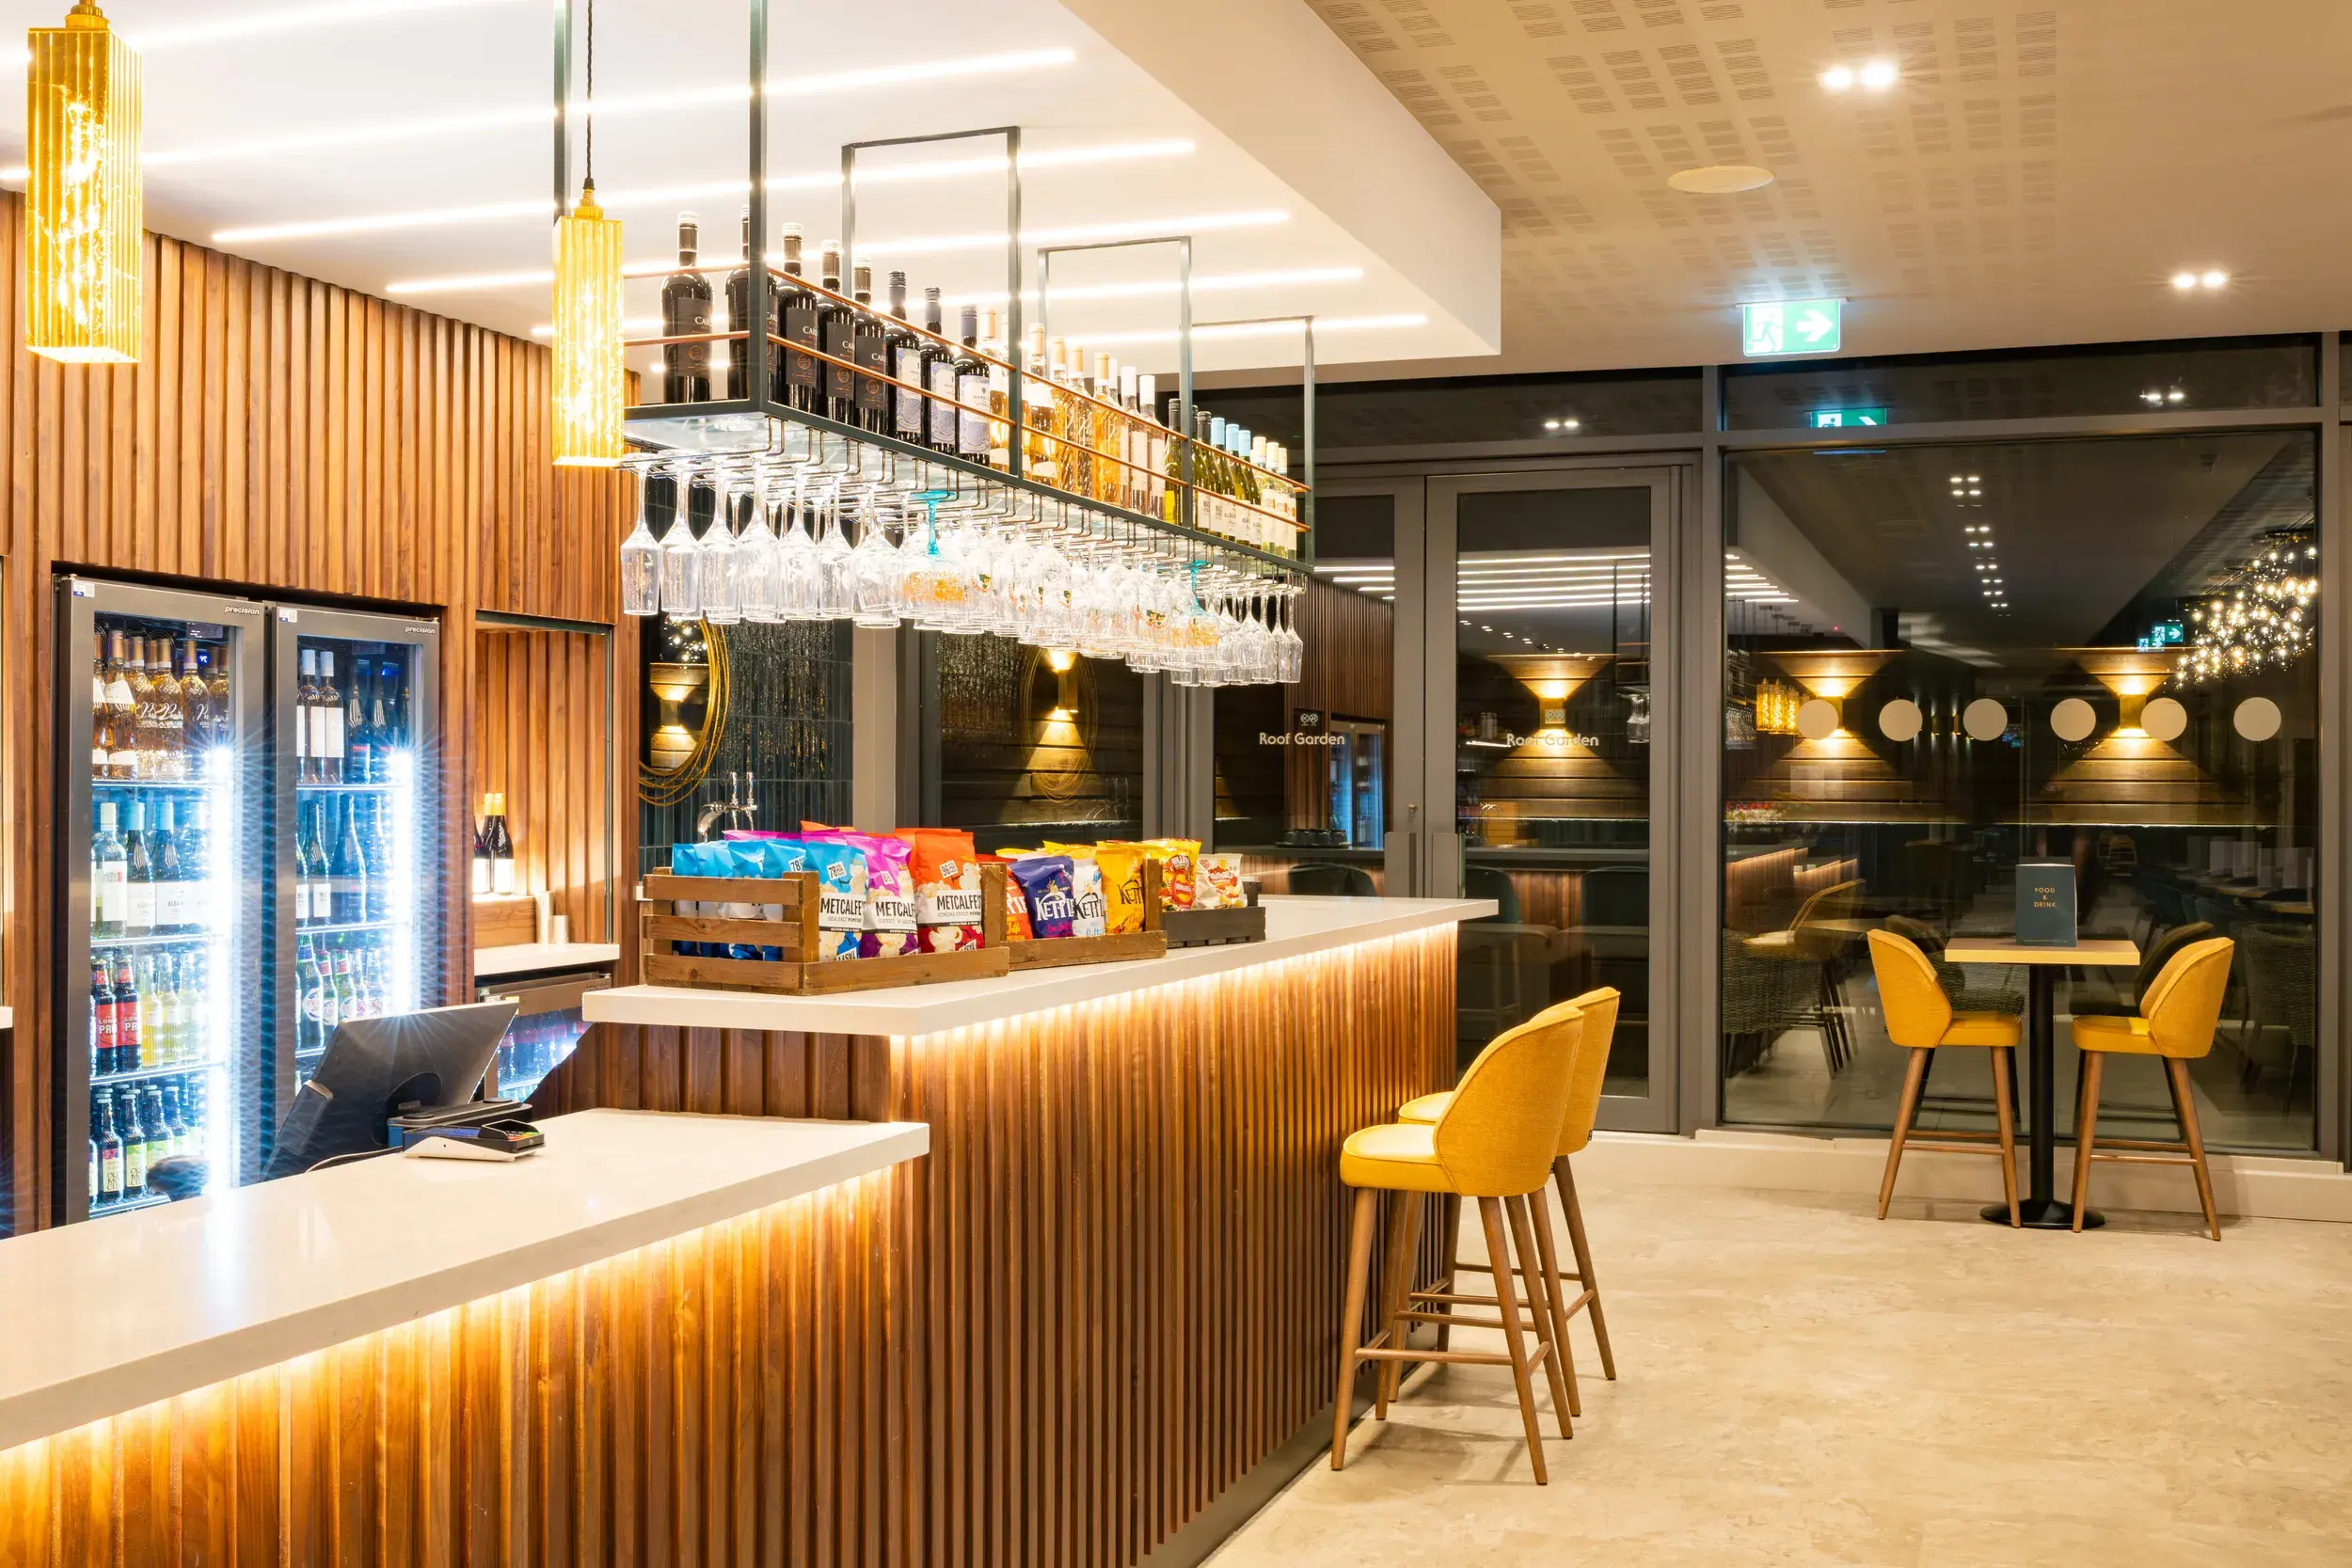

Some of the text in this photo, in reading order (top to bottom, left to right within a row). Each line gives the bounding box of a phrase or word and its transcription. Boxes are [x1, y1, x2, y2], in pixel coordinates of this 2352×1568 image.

[225, 605, 260, 615] precision
[405, 626, 436, 635] precision
[1259, 732, 1345, 745] Roof Garden
[1506, 733, 1599, 747] Roof Garden
[828, 865, 837, 879] 78
[1118, 879, 1143, 905] KETT
[876, 901, 916, 918] METCALF
[1035, 893, 1074, 921] KETTLE
[1073, 893, 1105, 921] KETTL
